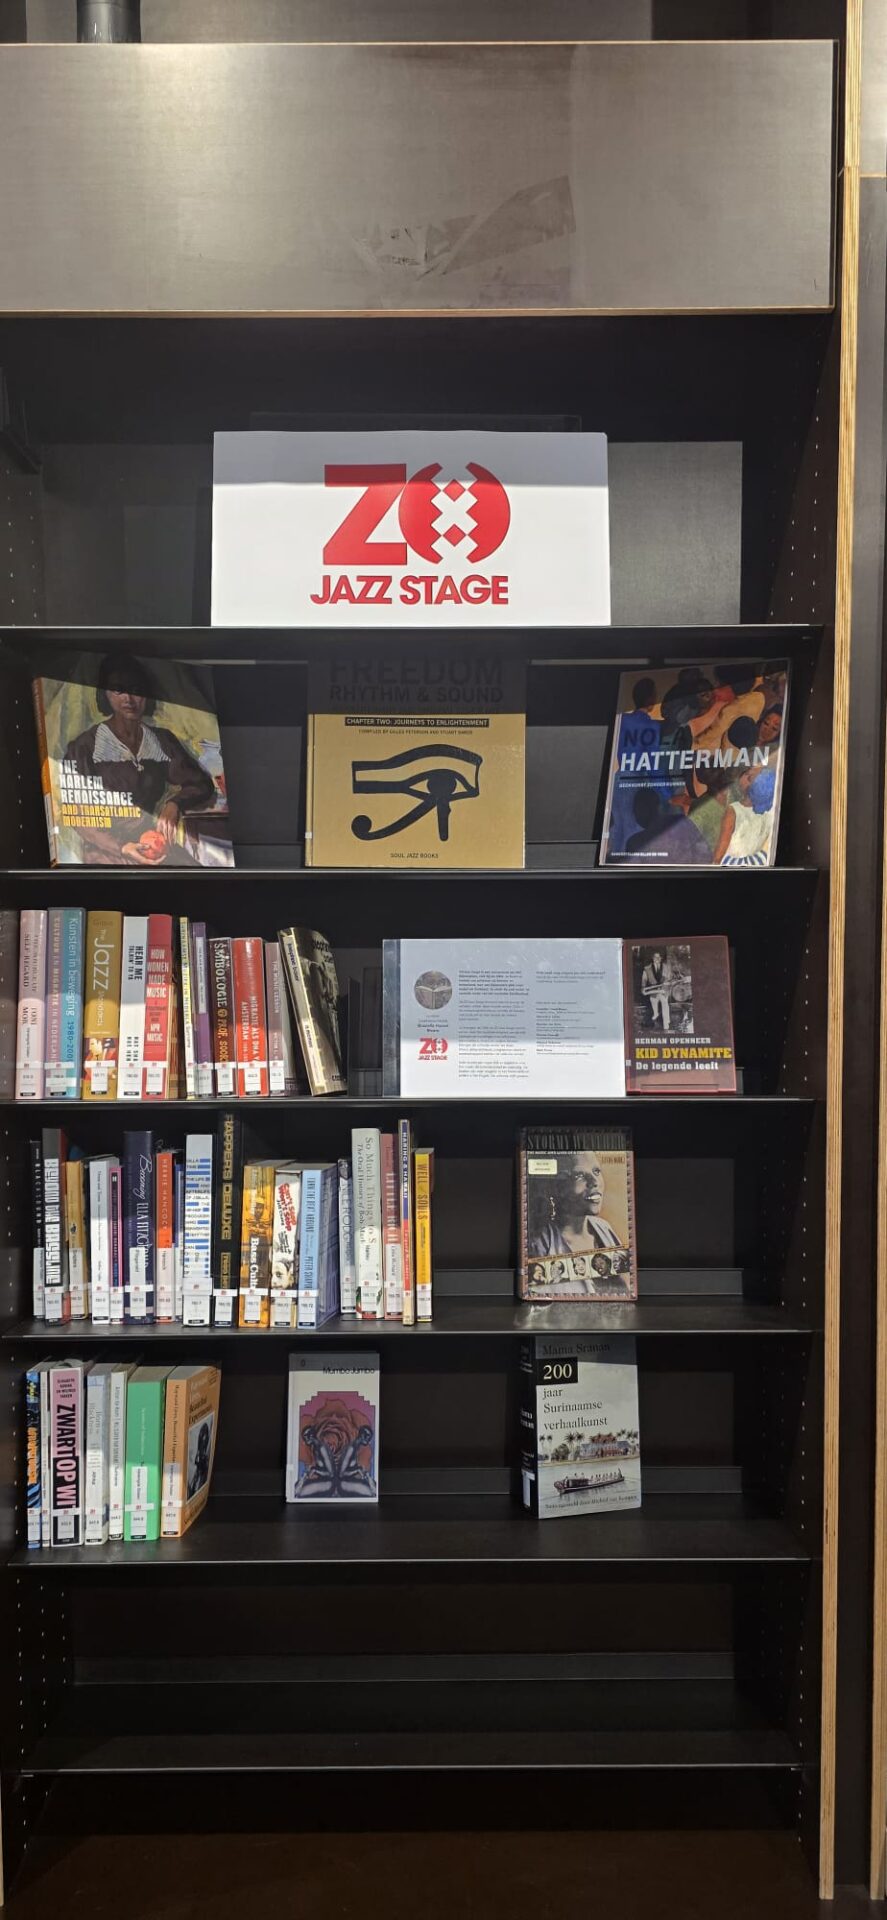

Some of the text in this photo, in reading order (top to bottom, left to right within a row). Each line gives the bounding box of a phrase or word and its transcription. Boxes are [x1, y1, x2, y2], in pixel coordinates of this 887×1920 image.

[310, 574, 508, 605] JAZZ STAGE
[330, 657, 503, 685] FREEDOM
[330, 686, 504, 703] RHYTHM & SOUND
[346, 718, 374, 726] CHAPTER
[394, 719, 425, 727] JOURNEYS
[427, 719, 436, 727] TO
[437, 719, 488, 728] ENLIGHTENMENT
[60, 760, 78, 775] THE
[619, 746, 770, 772] HATTERMAN
[60, 775, 104, 790] HARLEM
[61, 790, 134, 806] RENAISSANCE
[62, 804, 142, 818] AND TRANSATLANTIC
[63, 816, 112, 828] MODERNISM
[68, 918, 79, 956] Kunsten
[68, 958, 78, 967] in
[150, 949, 165, 960] HOW
[93, 940, 115, 990] Jazz
[134, 946, 144, 981] HEAR ME
[147, 962, 169, 973] WOMEN
[148, 974, 166, 985] MADE
[65, 970, 78, 1017] beweging
[146, 987, 167, 998] MUSIC
[52, 1008, 59, 1017] IN
[96, 990, 106, 1026] Standards
[250, 996, 258, 1025] MIGRATIE
[150, 1023, 161, 1033] NPR
[217, 1019, 228, 1039] PROF.
[240, 1001, 249, 1041] AMSTERDAM
[146, 1033, 163, 1043] MUSIC
[251, 1027, 259, 1039] ALS
[635, 1037, 711, 1045] HERMAN OPENNEER
[252, 1041, 260, 1055] DNA
[635, 1047, 733, 1059] KID DYNAMITE
[636, 1061, 719, 1072] De legende leeft
[526, 1134, 627, 1151] STORMY WEATHER
[222, 1114, 234, 1240] RAPPERS DELUXE
[416, 1163, 428, 1185] WELL
[132, 1154, 153, 1220] Becoming ELLA
[356, 1175, 365, 1200] History
[364, 1137, 377, 1235] So Much Things to
[385, 1172, 396, 1212] LITTLE
[278, 1184, 290, 1210] Won't
[284, 1211, 292, 1232] Stop
[283, 1183, 298, 1227] Can't Stop
[416, 1194, 429, 1221] SOULS
[44, 1158, 61, 1286] BEYOND THE BASSLINE
[249, 1237, 260, 1263] Bass
[304, 1256, 313, 1270] PETER
[543, 1342, 611, 1356] Mama Sranan
[322, 1366, 376, 1375] Mumbo Jumbo
[542, 1362, 573, 1381] 200
[542, 1387, 564, 1400] jaar
[543, 1400, 604, 1415] Surinaamse
[56, 1403, 77, 1457] ZWART
[543, 1416, 609, 1431] verhaalkunst
[56, 1458, 77, 1482] OP
[56, 1484, 77, 1509] WI
